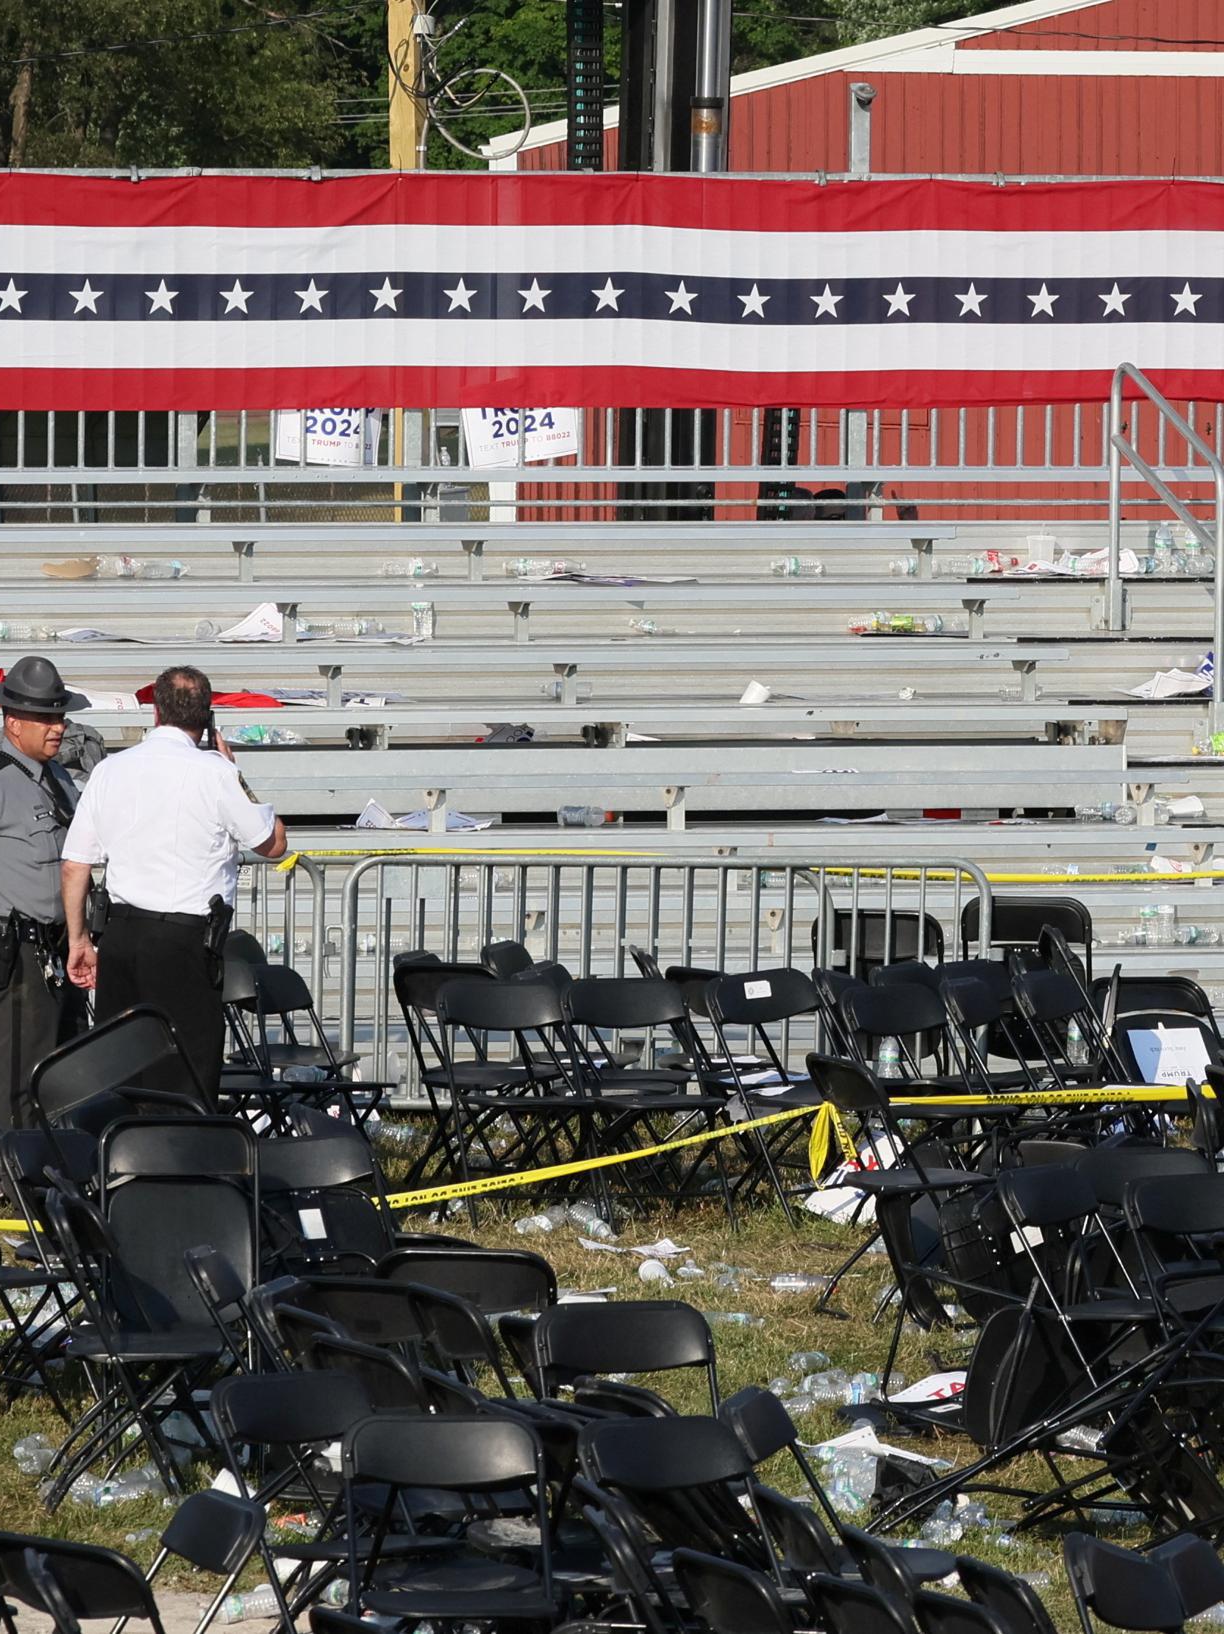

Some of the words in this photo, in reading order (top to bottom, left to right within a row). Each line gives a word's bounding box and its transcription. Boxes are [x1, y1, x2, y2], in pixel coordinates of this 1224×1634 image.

[491, 411, 555, 439] 2024
[311, 438, 342, 447] TRUMP
[531, 436, 543, 444] TO
[1161, 1070, 1192, 1078] TRUMP
